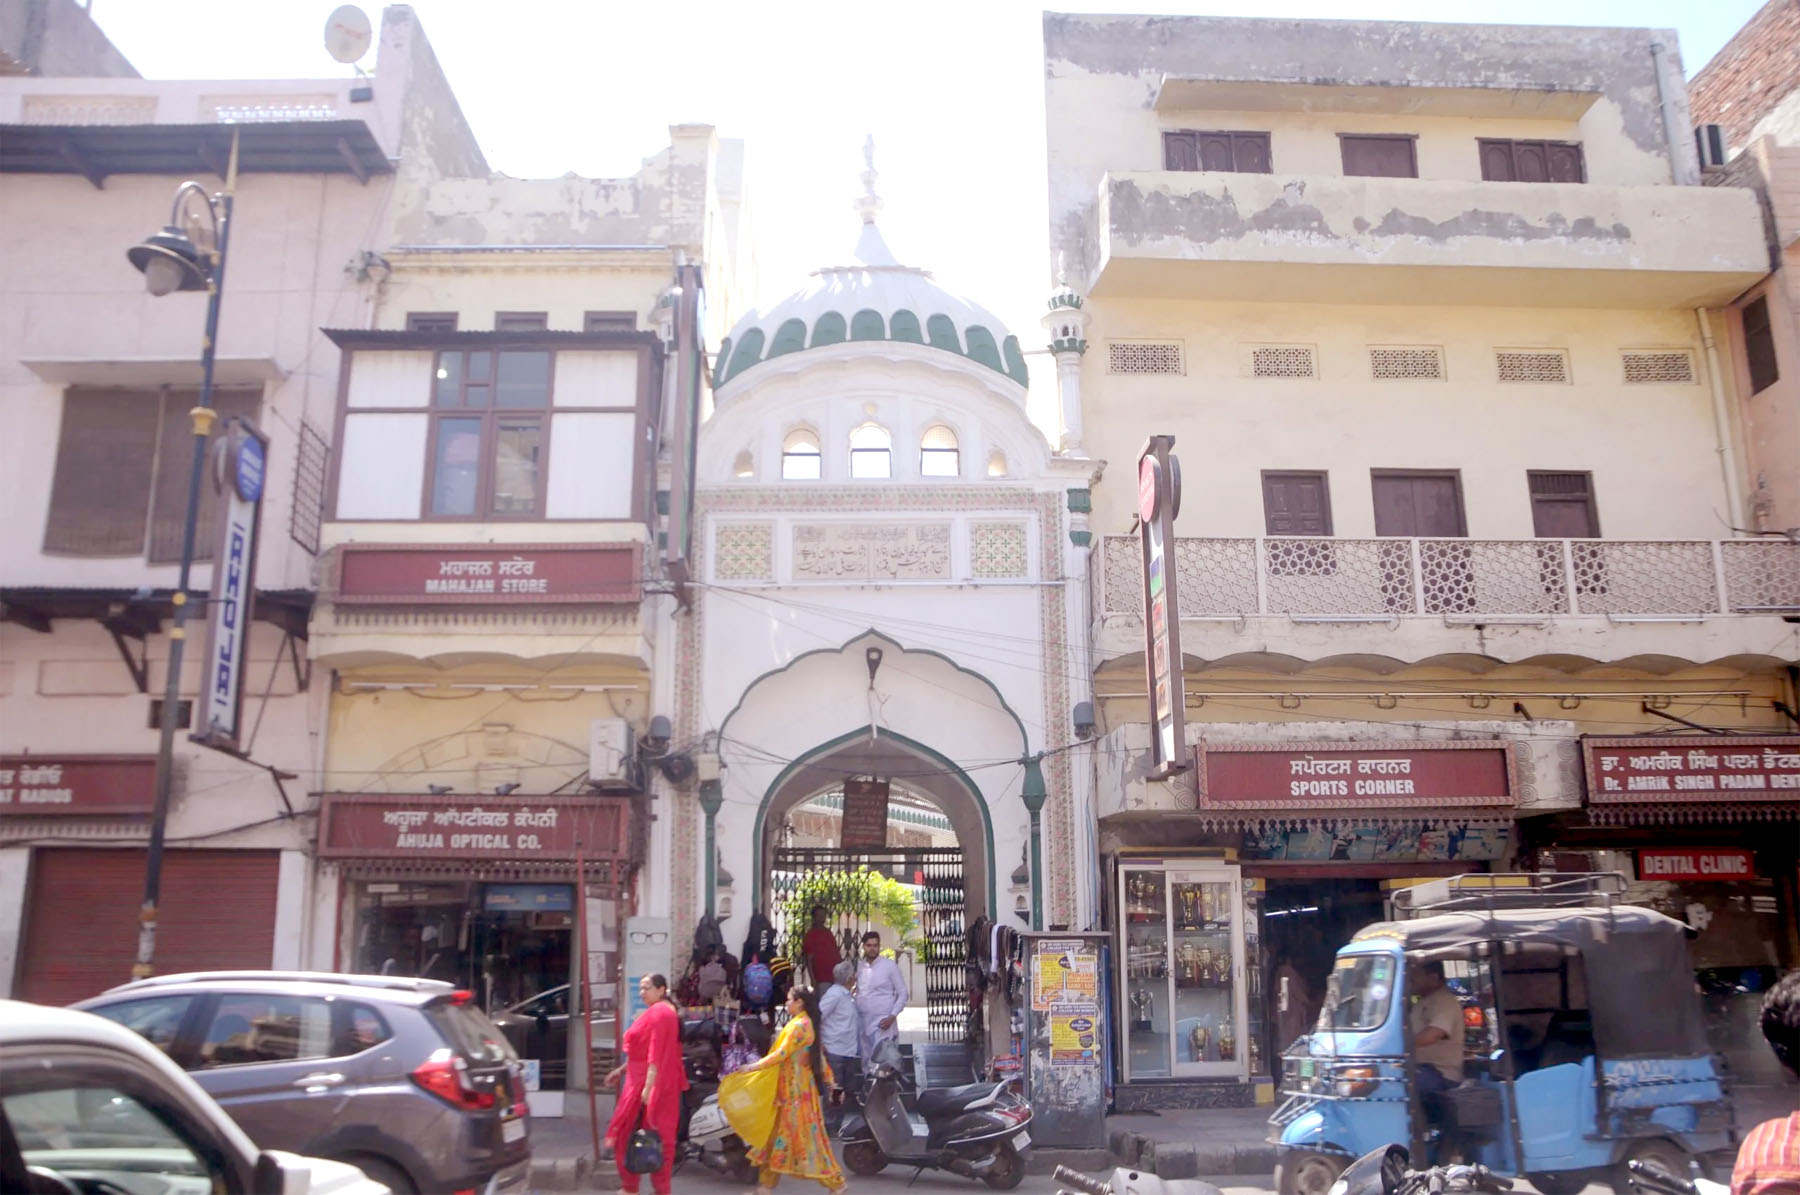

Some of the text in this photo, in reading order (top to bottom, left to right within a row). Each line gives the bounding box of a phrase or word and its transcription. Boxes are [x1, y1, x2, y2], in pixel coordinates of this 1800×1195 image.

[425, 579, 548, 593] MAHAJAN STORE
[1290, 754, 1412, 775] ਸਪੋਰਟਸ ਕਾਰਨਰ
[1290, 779, 1415, 796] SPORTS CORNER
[1627, 776, 1671, 790] AMRIK
[1674, 775, 1715, 790] SINGH
[1719, 774, 1766, 789] PADAM
[396, 834, 542, 849] AHUJA OPTICAL CO.
[1644, 855, 1748, 874] DENTAL CLINIC
